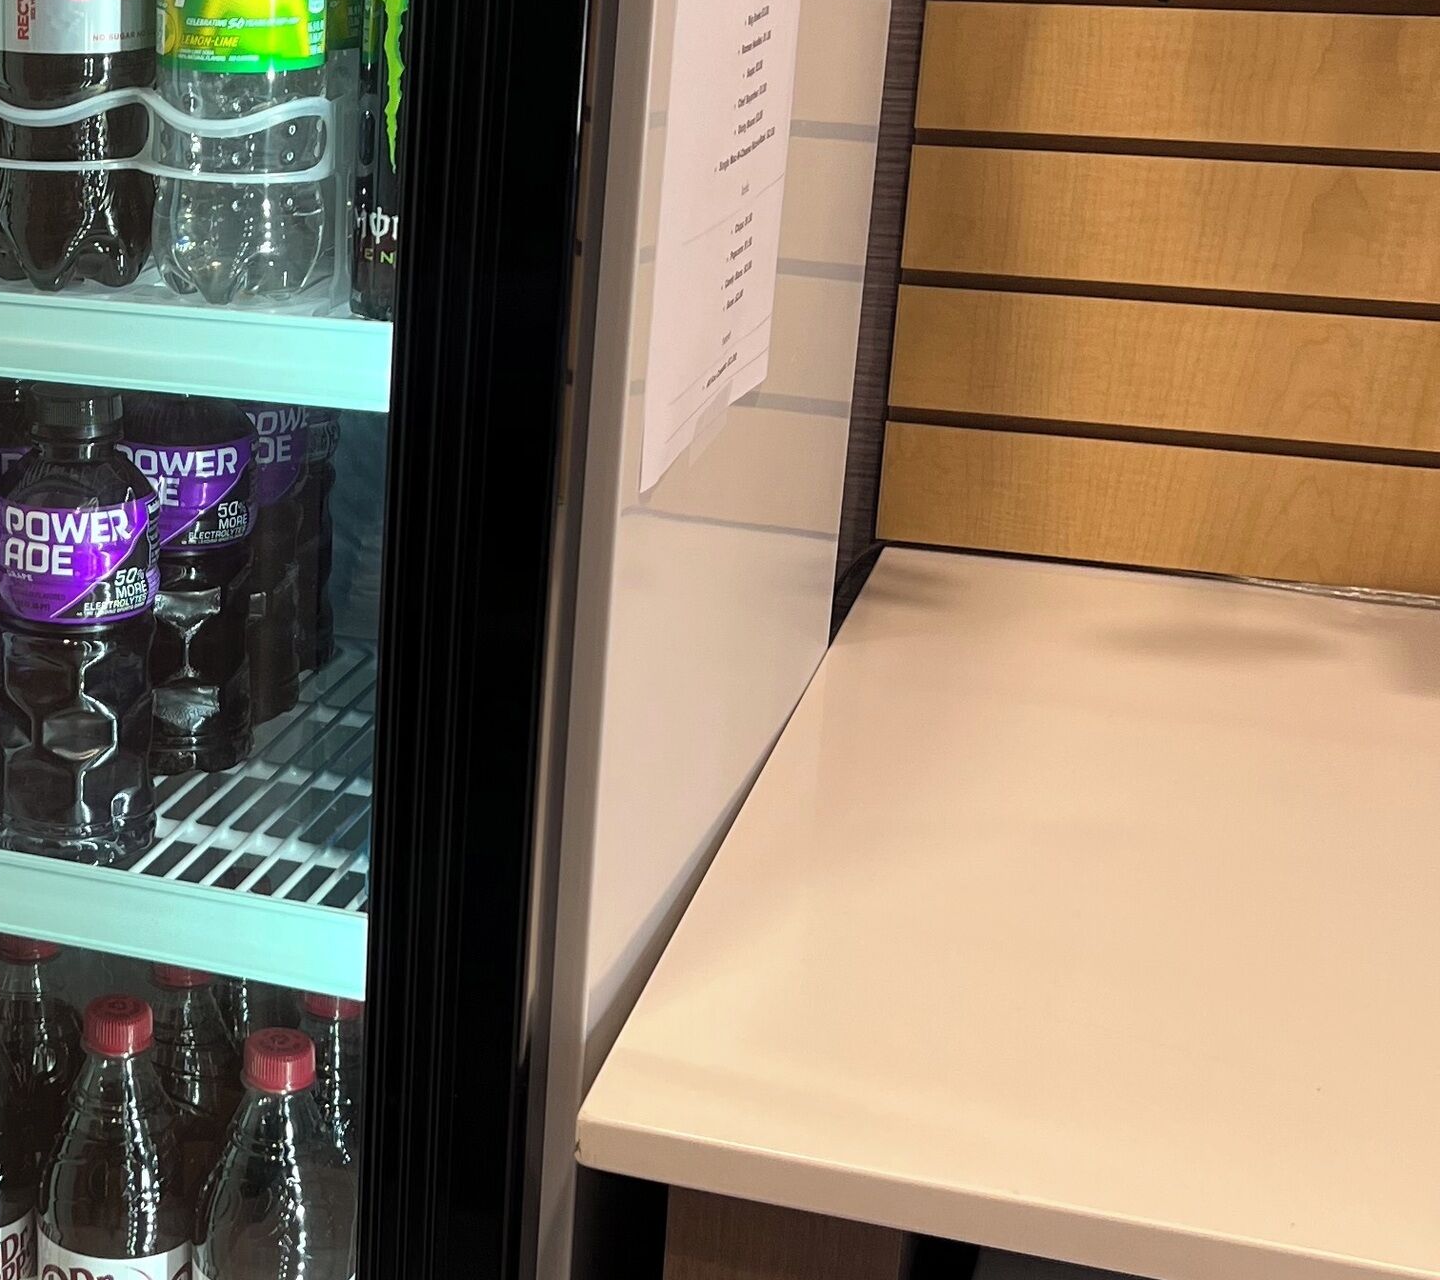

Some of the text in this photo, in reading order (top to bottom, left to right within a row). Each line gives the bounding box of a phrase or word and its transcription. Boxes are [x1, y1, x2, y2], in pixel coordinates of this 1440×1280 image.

[93, 32, 135, 41] NO SUGAR
[182, 34, 239, 48] LEMON-LIME
[5, 505, 132, 544] POWER
[219, 513, 248, 530] MORE
[4, 536, 74, 576] ADE
[114, 567, 146, 586] 50%
[115, 580, 148, 599] MORE
